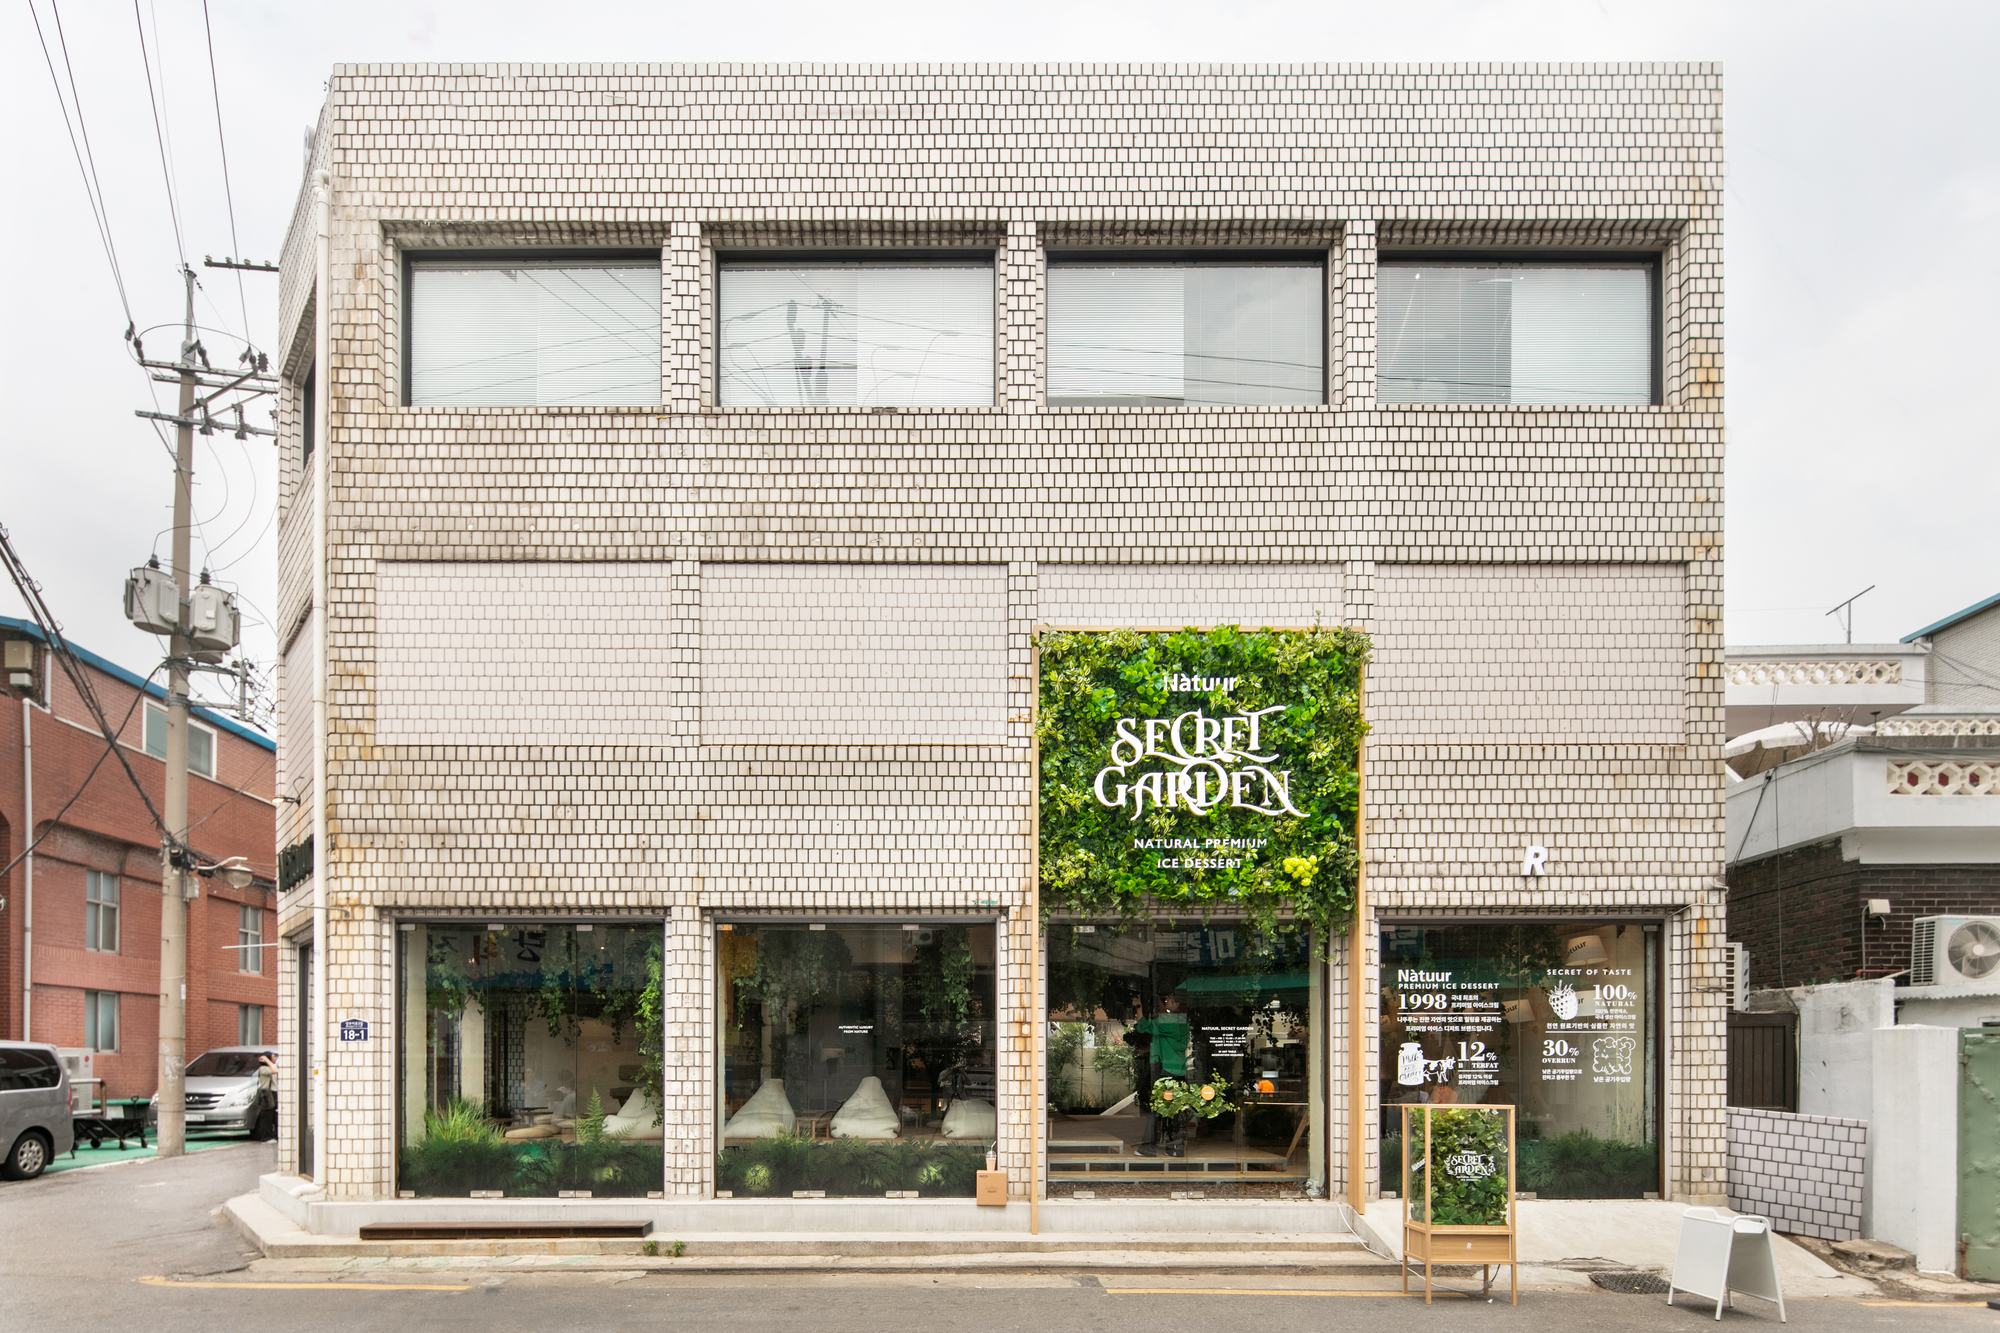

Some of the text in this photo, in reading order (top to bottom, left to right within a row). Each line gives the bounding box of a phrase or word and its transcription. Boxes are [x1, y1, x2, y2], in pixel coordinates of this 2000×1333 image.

[1111, 705, 1287, 768] SECRET
[1094, 760, 1311, 821] GARDEN
[1134, 838, 1268, 849] NATURAL PREMIUM
[1157, 858, 1242, 869] ICE DESSERT
[1521, 845, 1549, 876] R
[1398, 968, 1452, 982] Nàtuur
[1546, 968, 1632, 976] SECRET OF TASTE
[1593, 984, 1638, 1001] 100%
[1398, 993, 1447, 1010] 1998
[343, 1029, 365, 1040] 18-1
[1457, 1041, 1498, 1062] 12%
[1542, 1039, 1580, 1057] 30%
[1450, 1154, 1488, 1166] SECRET
